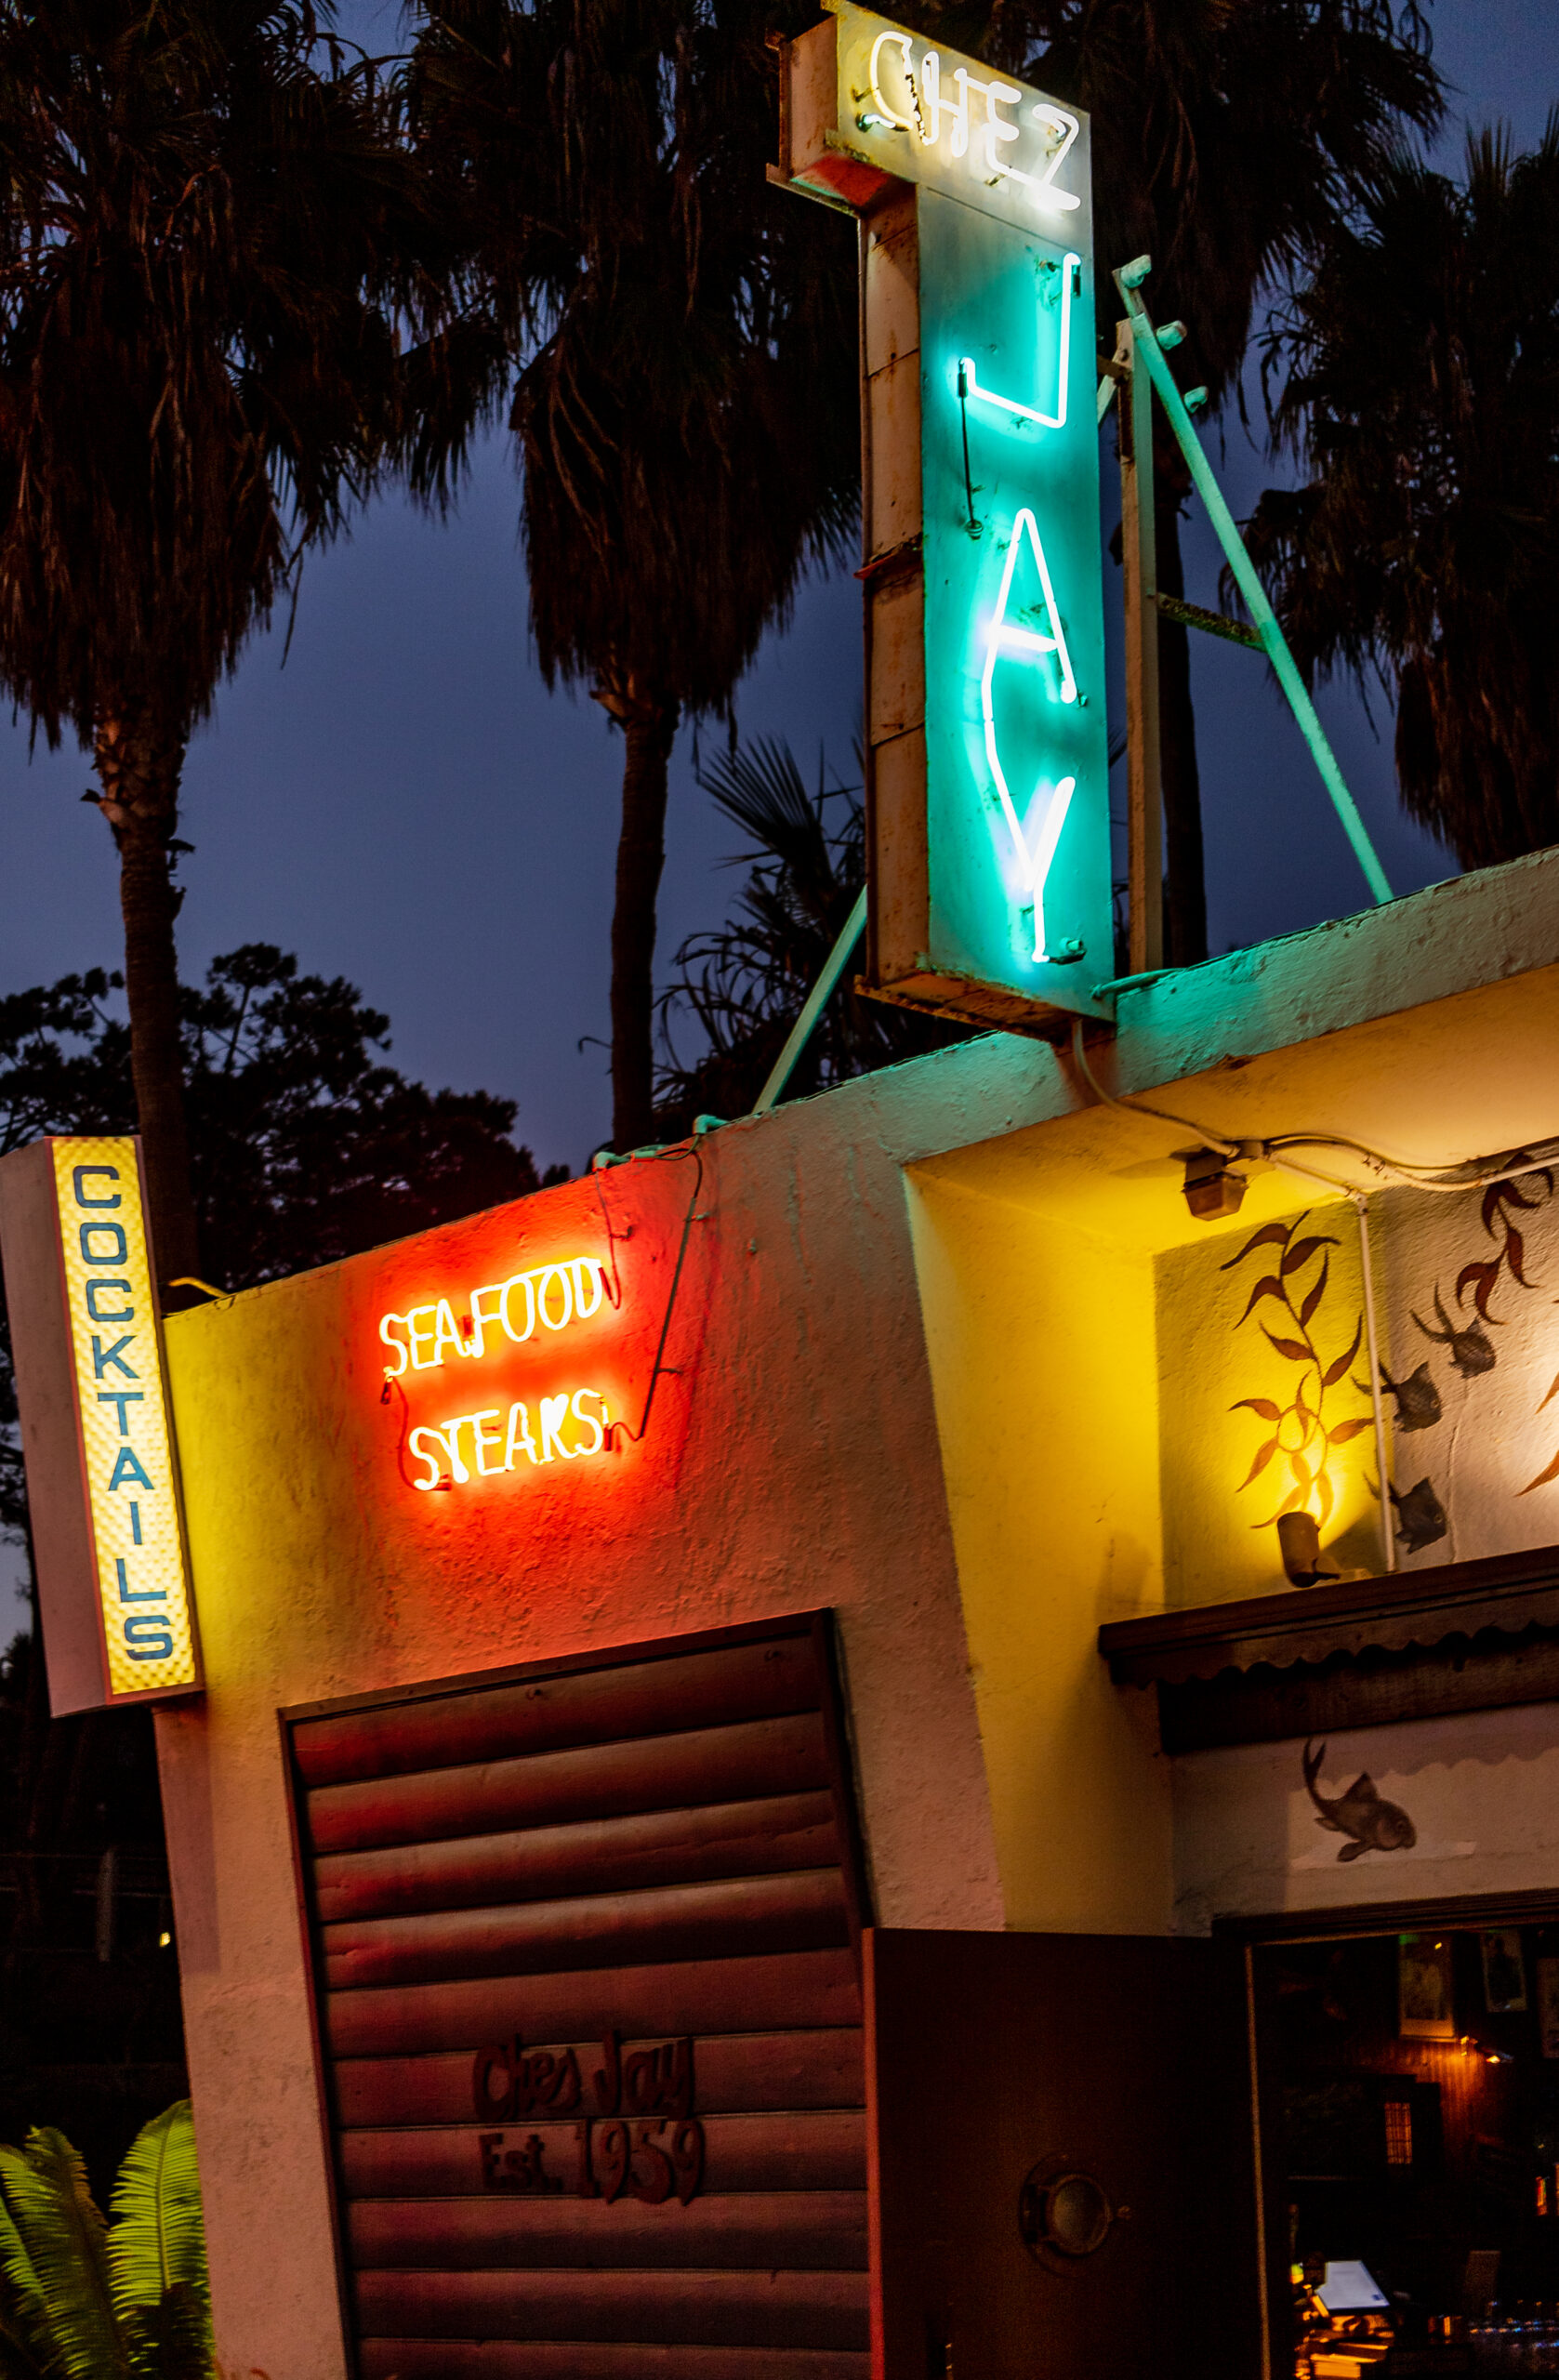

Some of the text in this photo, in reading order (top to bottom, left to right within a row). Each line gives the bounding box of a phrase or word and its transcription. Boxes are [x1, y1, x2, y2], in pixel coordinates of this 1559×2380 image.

[870, 31, 1081, 211] CHEZ
[958, 252, 1081, 963] JAY
[379, 1257, 603, 1377] SEAFOOD
[72, 1165, 174, 1662] COCKTAILS
[409, 1388, 605, 1491] STEAKS
[594, 2029, 696, 2121] Jay
[479, 2118, 705, 2206] Est. 1959
